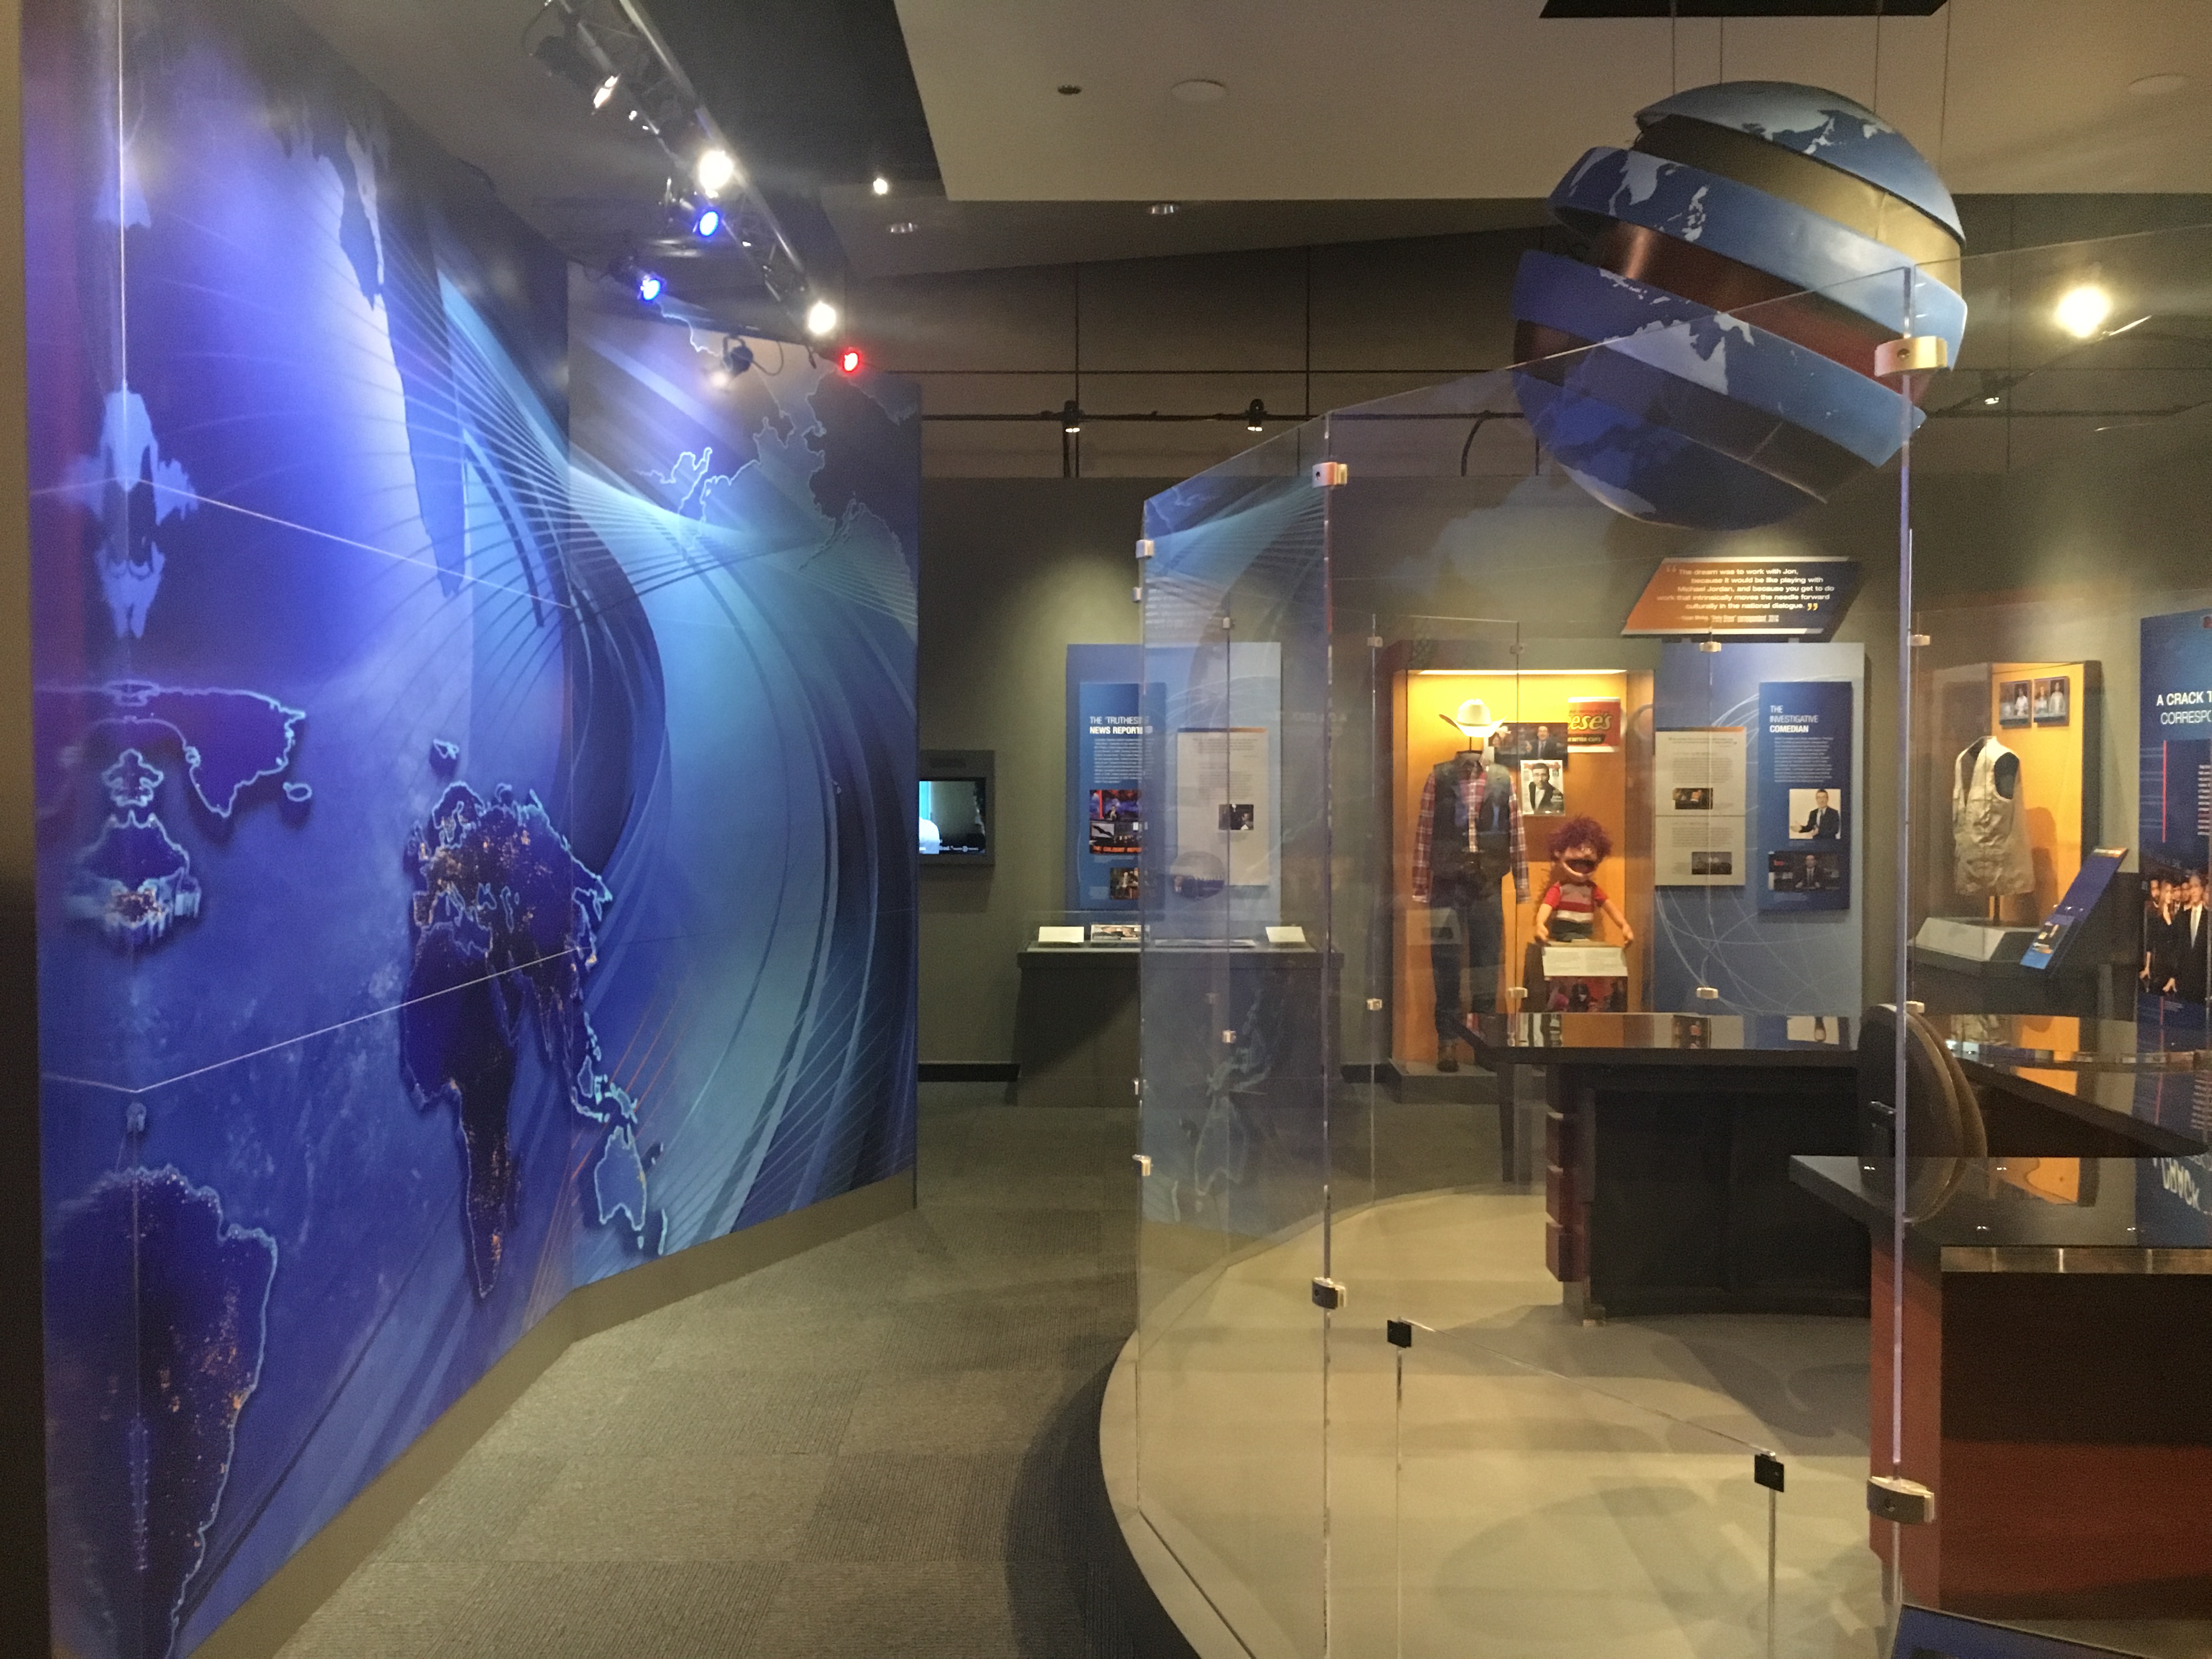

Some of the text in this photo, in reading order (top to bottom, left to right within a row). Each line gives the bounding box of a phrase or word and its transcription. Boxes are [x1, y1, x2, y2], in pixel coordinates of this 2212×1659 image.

[2156, 695, 2164, 706] A
[2166, 691, 2204, 706] CRACK
[1770, 705, 1784, 713] THE
[1090, 716, 1103, 724] THE
[1769, 714, 1819, 723] INVESTIGATIVE
[1089, 726, 1111, 735] NEWS
[1769, 725, 1809, 733] COMEDIAN
